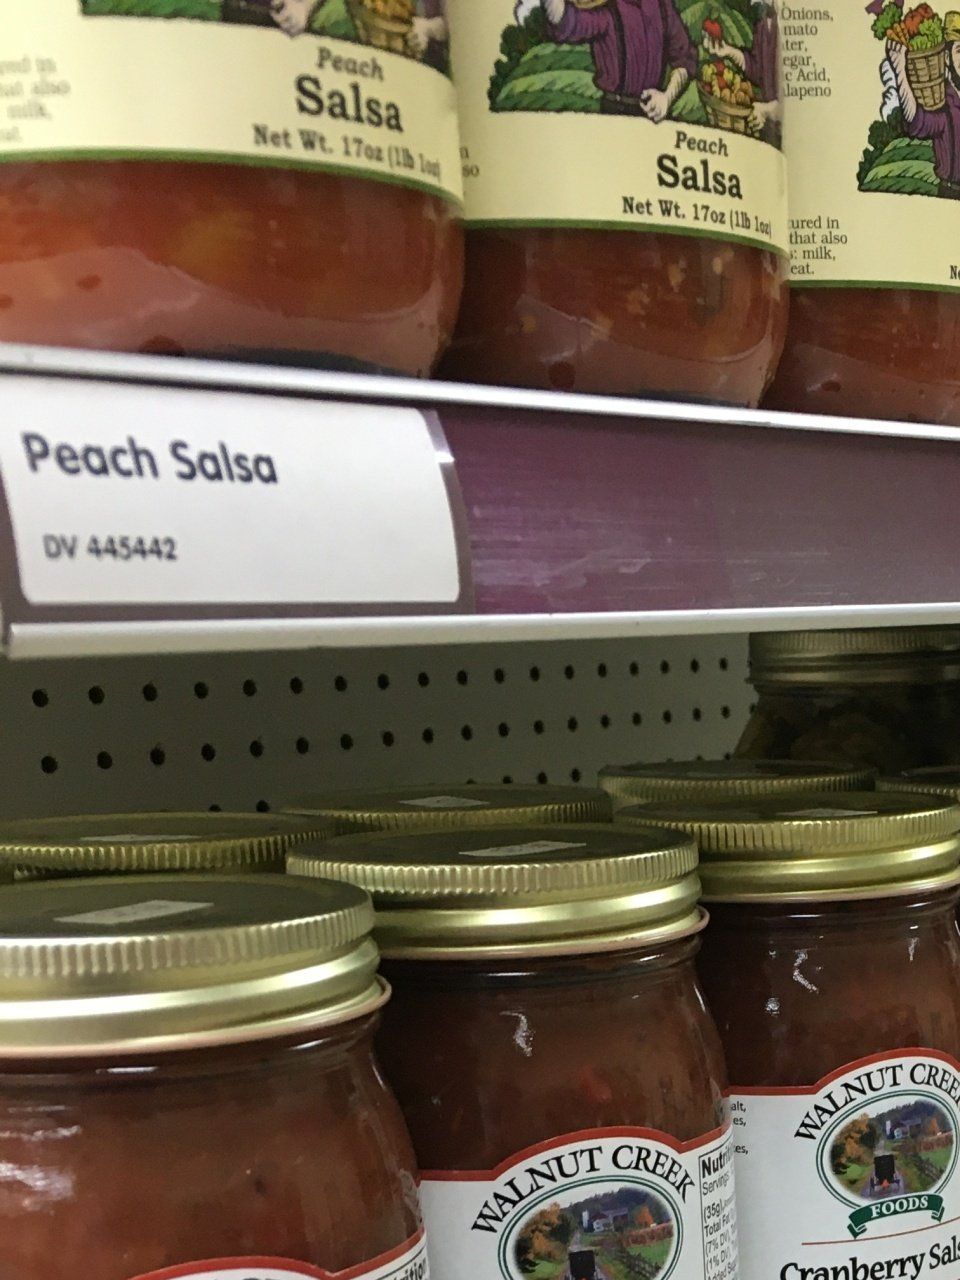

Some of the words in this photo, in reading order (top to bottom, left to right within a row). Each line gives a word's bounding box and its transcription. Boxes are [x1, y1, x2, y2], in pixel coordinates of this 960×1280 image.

[316, 45, 385, 82] Peach
[293, 73, 404, 133] Salsa
[252, 123, 292, 150] Net
[299, 129, 334, 155] Wt.
[341, 135, 384, 163] 17oz
[674, 130, 729, 158] Peach
[656, 155, 743, 200] Salsa
[621, 196, 654, 217] Net
[658, 199, 686, 220] Wt.
[692, 204, 725, 225] 17oz
[20, 430, 161, 481] Peach
[169, 440, 280, 485] Salsa
[42, 533, 79, 561] DV
[86, 534, 179, 563] 445442
[793, 1063, 904, 1143] WALNUT
[470, 1146, 604, 1237] WALNUT
[610, 1145, 696, 1204] CREEK
[869, 1194, 930, 1220] FOODS
